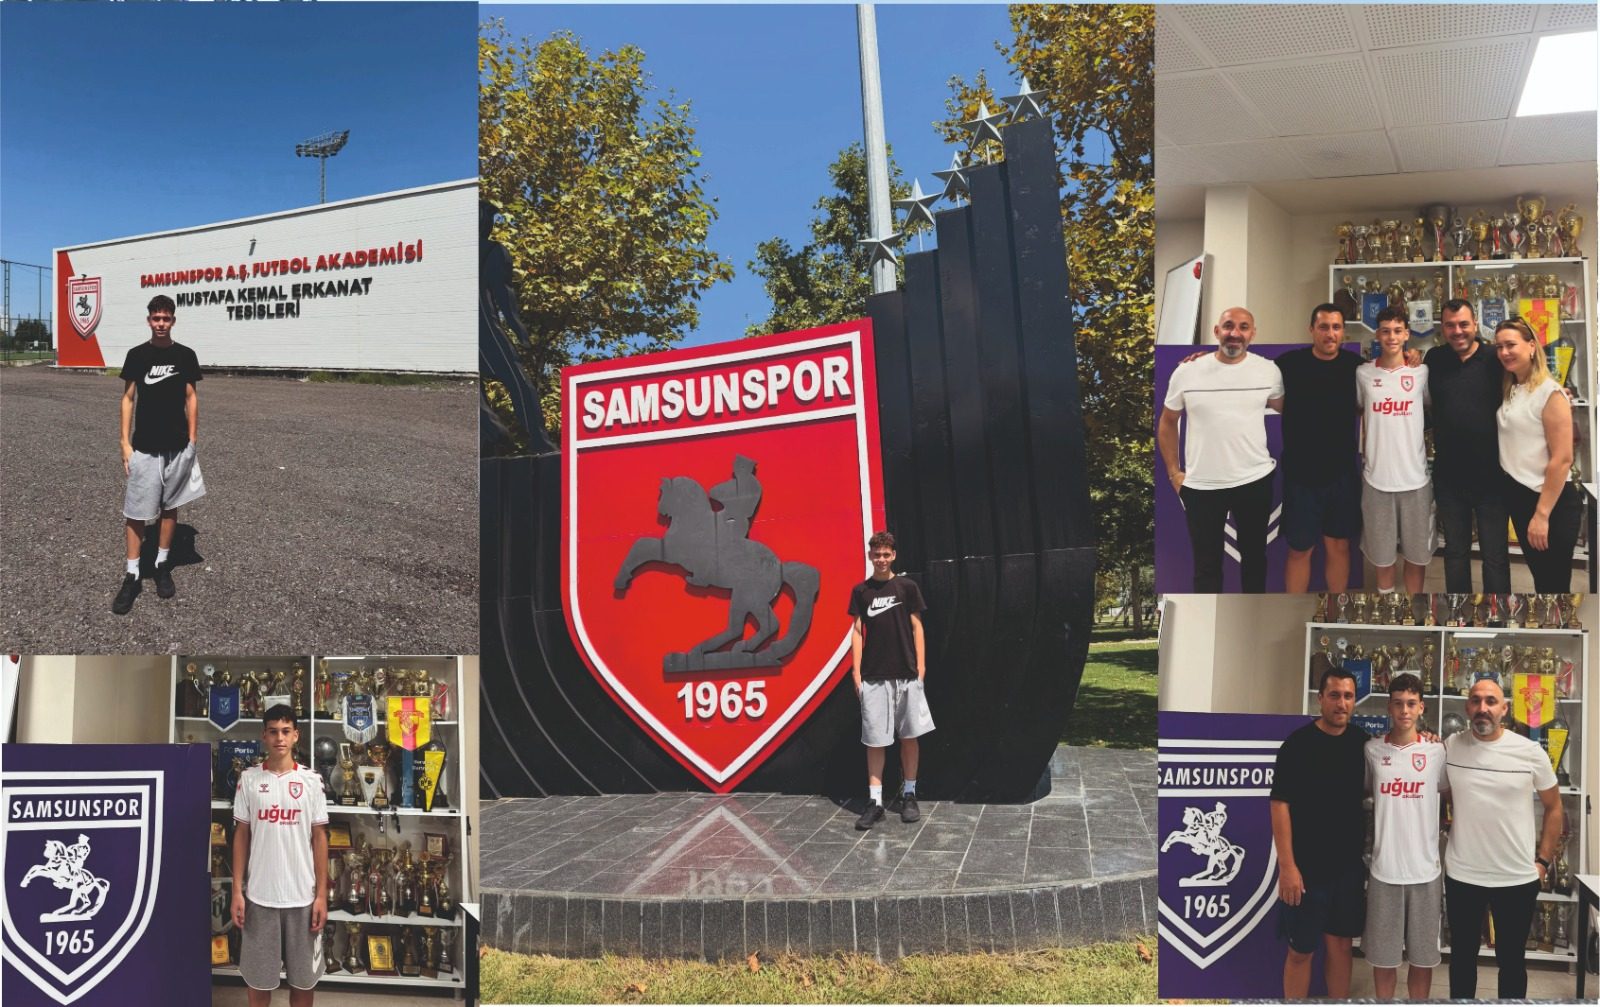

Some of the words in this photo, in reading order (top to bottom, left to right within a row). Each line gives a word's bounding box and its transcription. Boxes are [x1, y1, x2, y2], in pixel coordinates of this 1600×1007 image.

[140, 266, 223, 288] SAMSUNSPOR
[252, 256, 311, 278] FUTBOL
[315, 239, 423, 272] AKADEMİSİ
[176, 289, 235, 308] MUSTAFA
[237, 284, 288, 304] KEMAL
[291, 276, 373, 300] ERKANAT
[226, 299, 300, 321] TESİSLERİ
[149, 364, 176, 376] NIKE
[582, 356, 852, 429] SAMSUNSPOR
[1372, 397, 1413, 414] uğur
[871, 595, 897, 609] NIKE
[676, 681, 768, 719] 1965
[1364, 721, 1385, 729] Porto
[234, 747, 255, 755] Porto
[1380, 777, 1425, 796] uğur
[12, 798, 140, 820] SAMSUNSPOR
[258, 805, 301, 823] uğur
[1183, 894, 1231, 919] 1965
[44, 929, 96, 956] 1965
